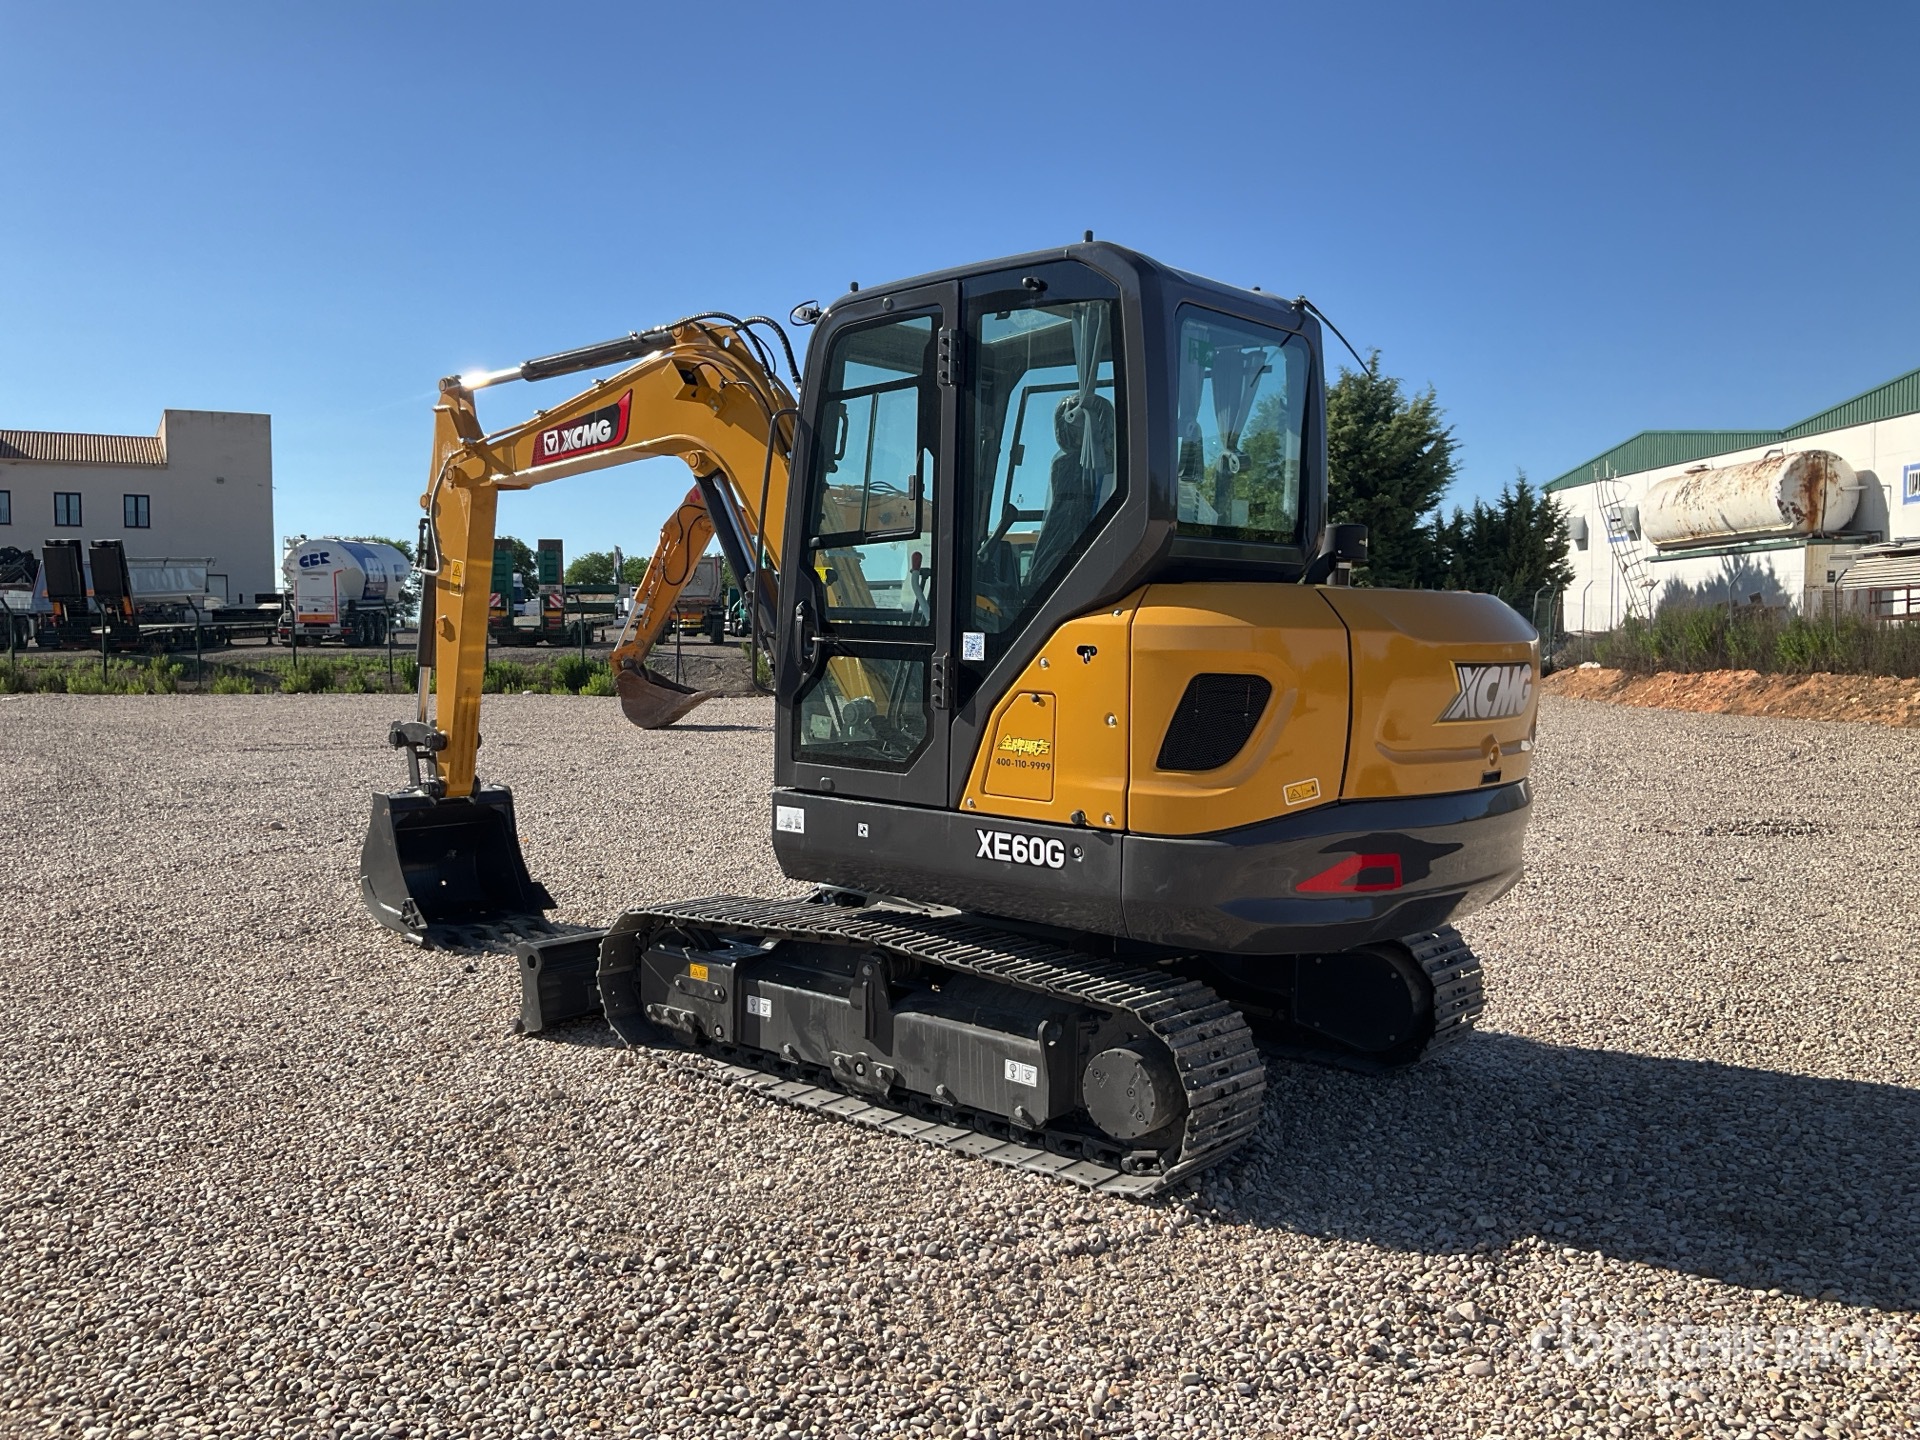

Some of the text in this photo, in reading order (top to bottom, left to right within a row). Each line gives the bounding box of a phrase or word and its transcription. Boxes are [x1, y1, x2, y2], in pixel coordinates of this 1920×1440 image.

[560, 419, 611, 452] XCMG
[1443, 664, 1532, 719] XCMG
[998, 734, 1051, 756] 金牌服务
[996, 758, 1051, 770] 400-110-9999
[976, 829, 1065, 869] XE60G
